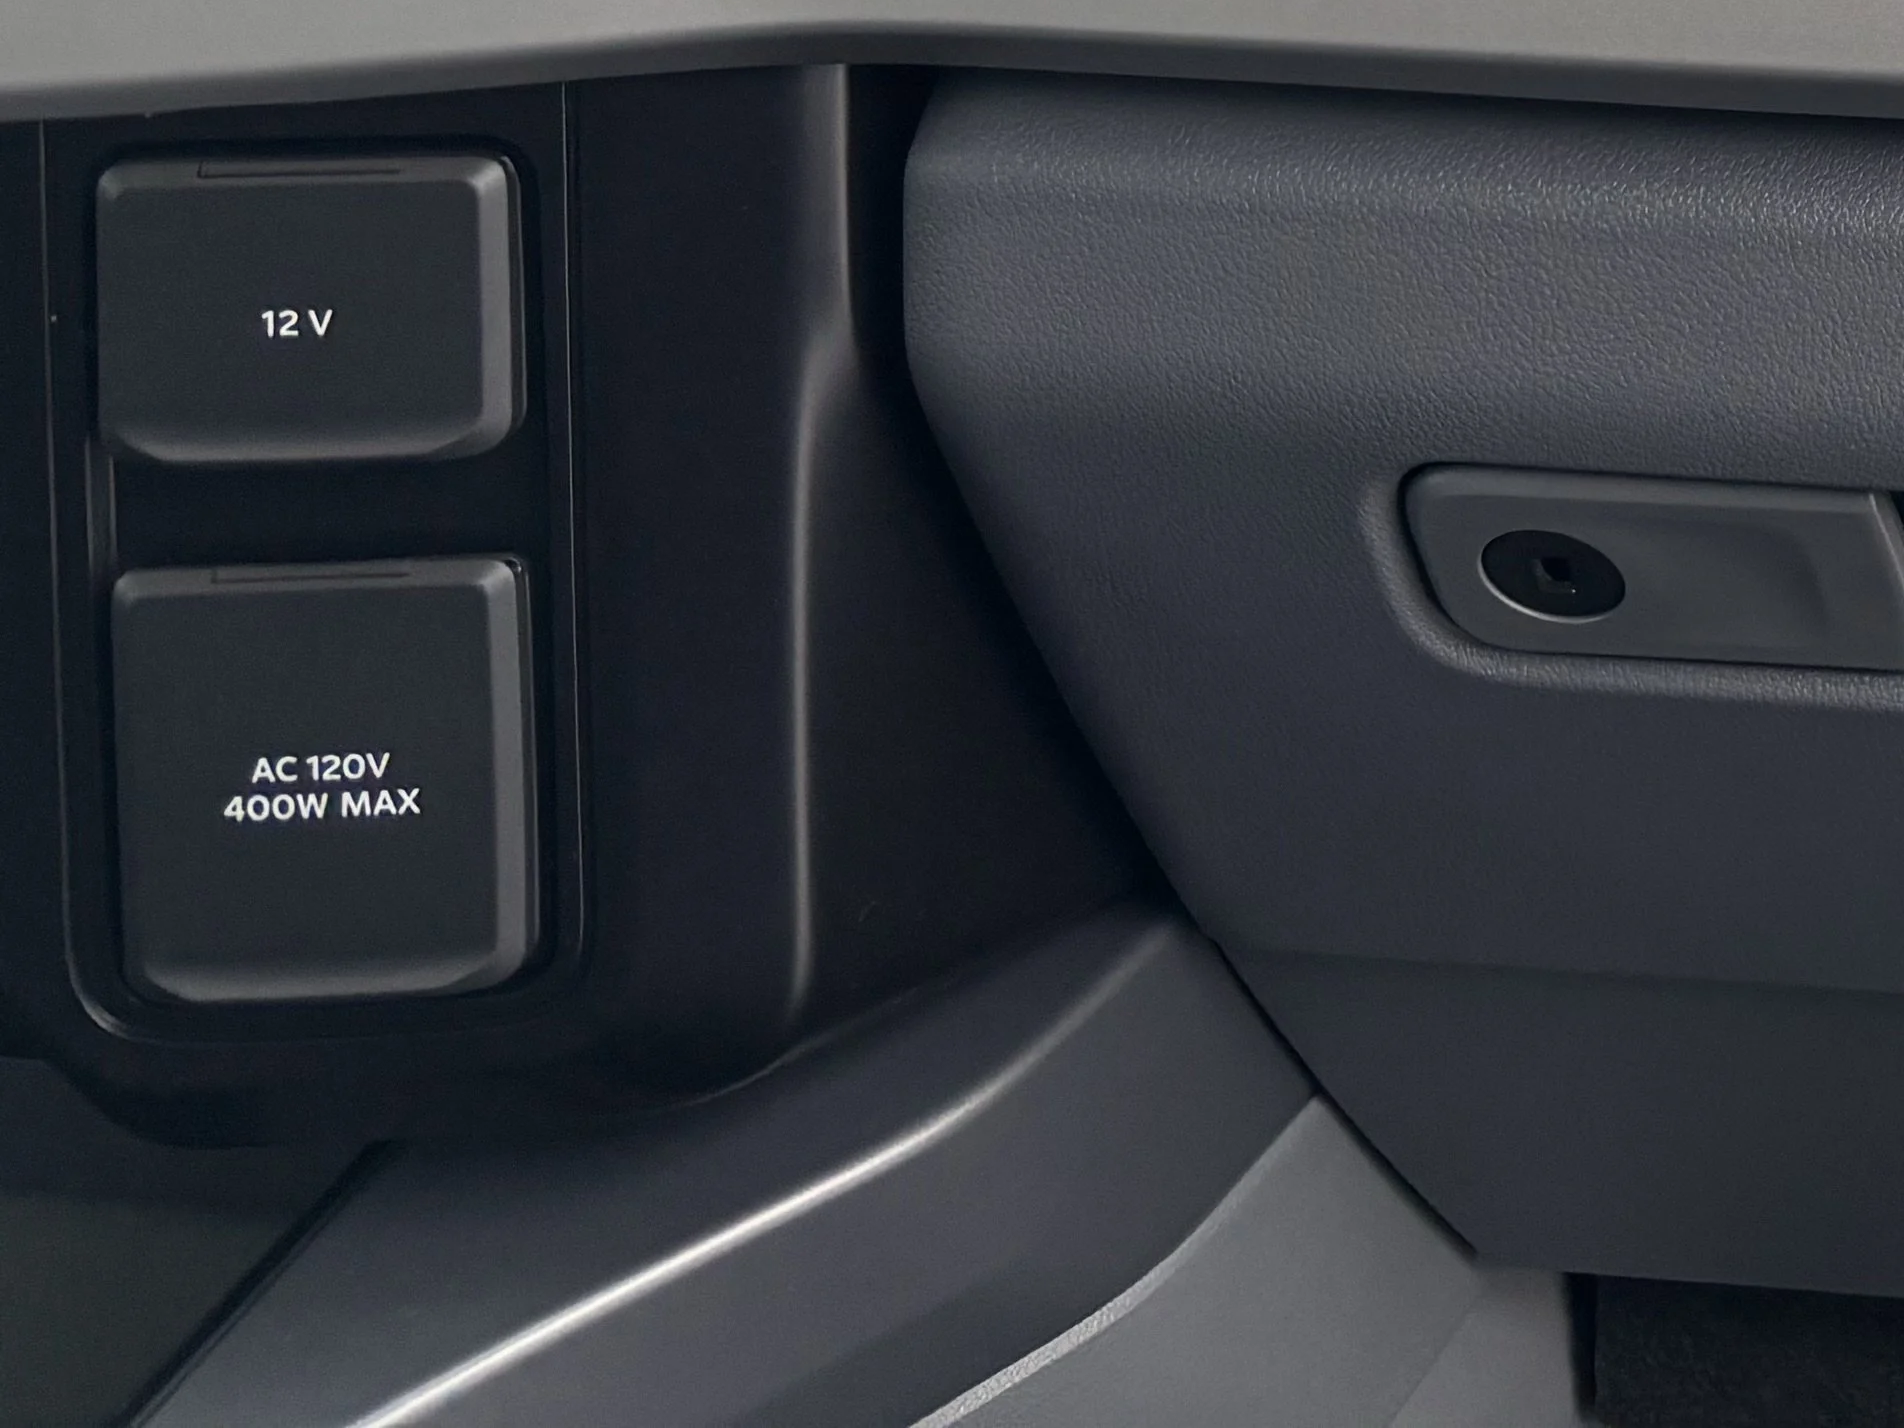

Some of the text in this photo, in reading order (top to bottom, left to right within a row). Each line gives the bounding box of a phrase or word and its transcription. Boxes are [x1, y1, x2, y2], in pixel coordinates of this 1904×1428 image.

[262, 309, 332, 337] 12 V
[252, 753, 390, 783] AC 120V
[224, 788, 420, 821] 400W MAX
